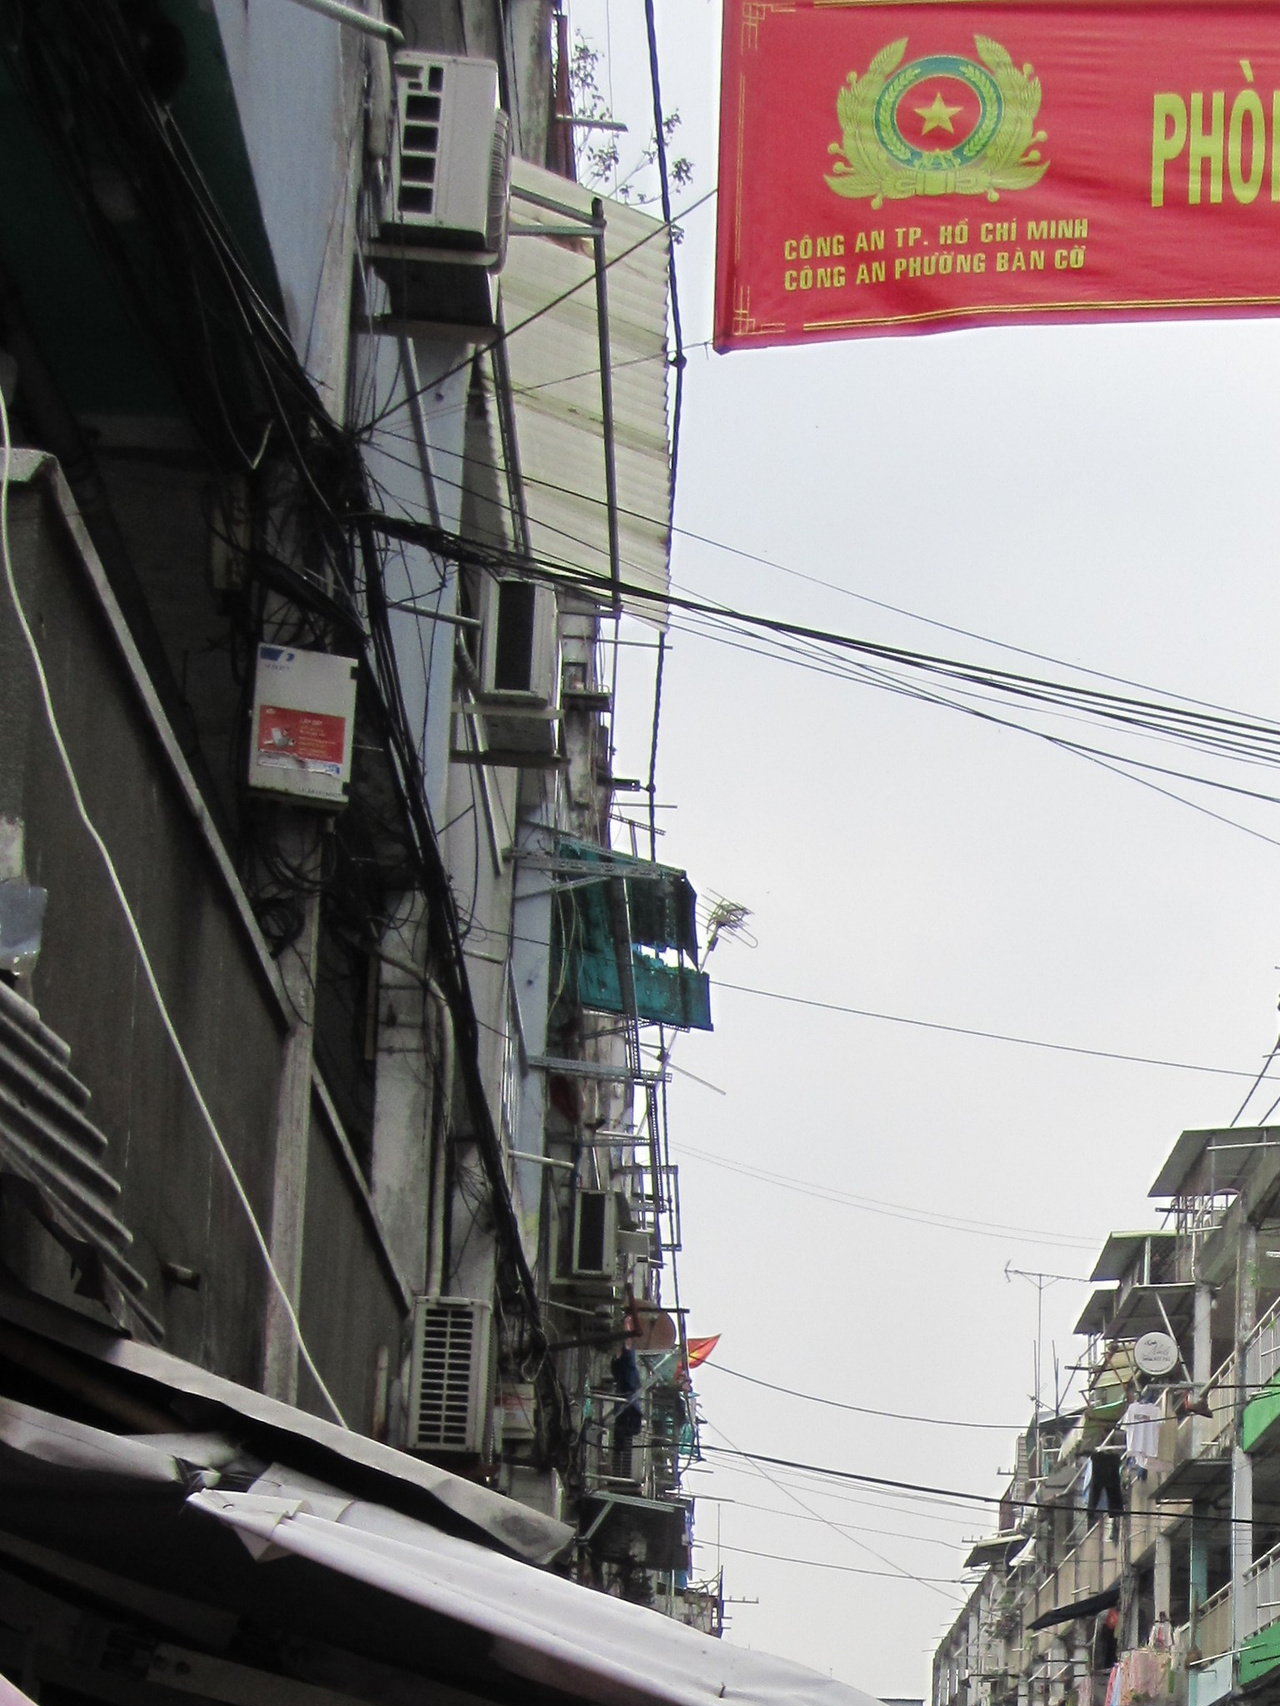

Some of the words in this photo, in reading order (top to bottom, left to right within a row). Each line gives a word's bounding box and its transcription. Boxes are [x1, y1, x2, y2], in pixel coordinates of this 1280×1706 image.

[784, 235, 844, 260] CÔNG
[855, 230, 885, 252] AN
[895, 226, 929, 248] TP.
[939, 217, 969, 245] HỒ
[980, 218, 1017, 243] CHÍ
[1027, 218, 1089, 241] MINH
[784, 265, 846, 291] CÔNG
[855, 261, 886, 285] AN
[895, 250, 986, 280] PHƯỜNG
[996, 247, 1044, 273] BÀN
[1054, 245, 1086, 269] CỜ
